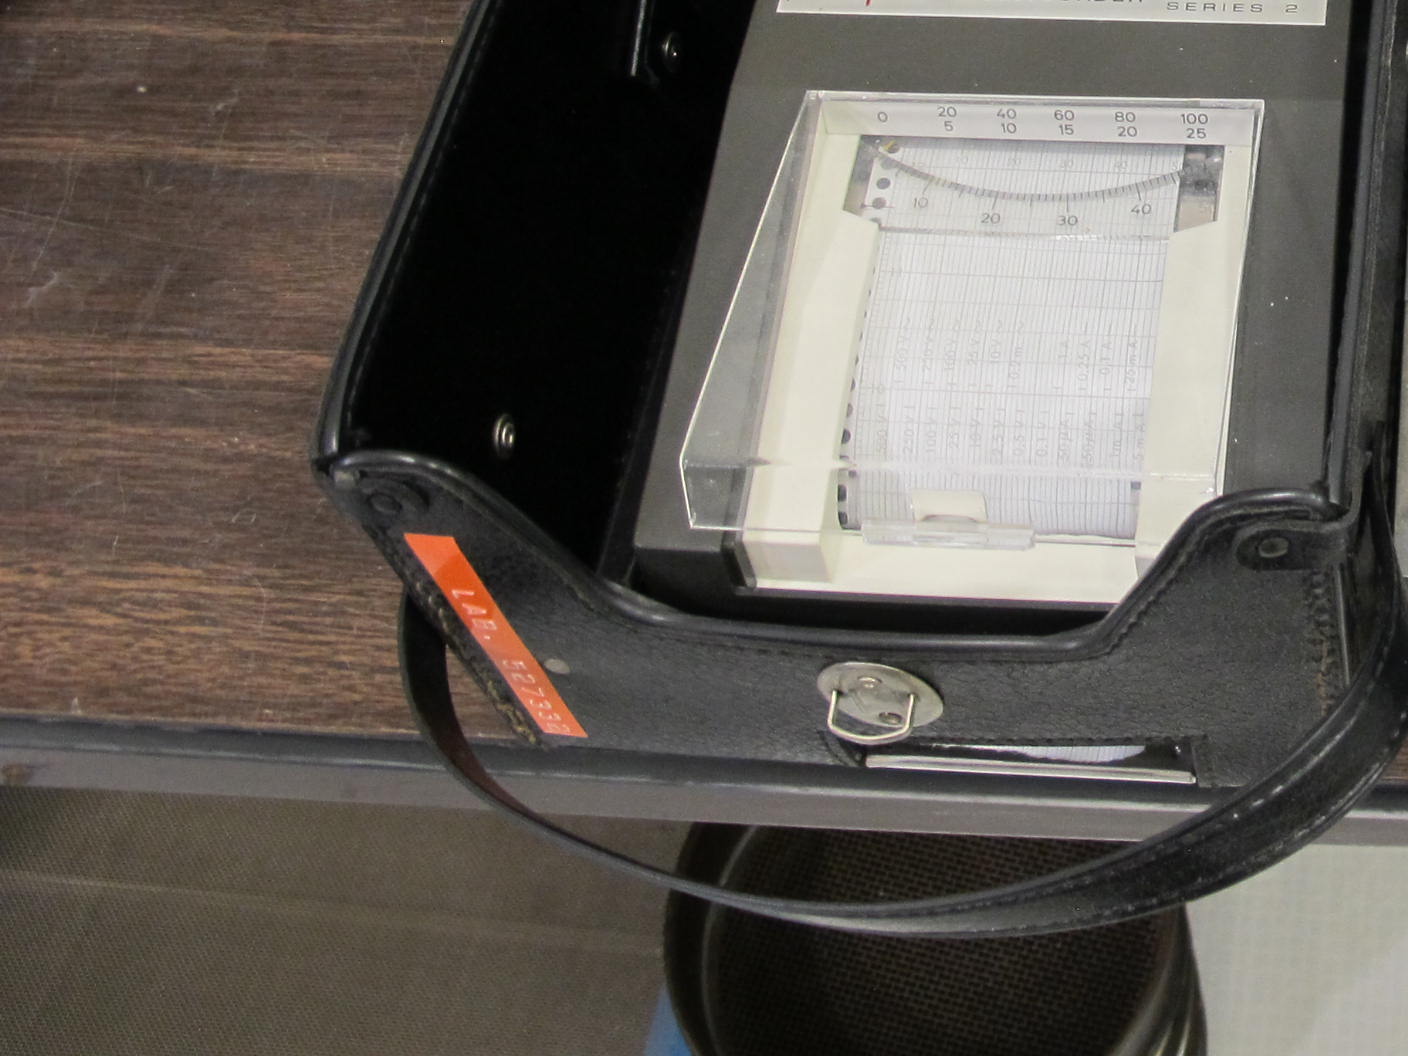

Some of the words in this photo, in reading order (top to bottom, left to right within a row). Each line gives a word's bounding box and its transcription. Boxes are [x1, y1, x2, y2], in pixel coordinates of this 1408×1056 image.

[1166, 1, 1264, 13] SERIES
[1285, 3, 1299, 14] 2
[876, 111, 888, 123] 0
[937, 106, 957, 118] 20
[996, 107, 1017, 120] 40
[1054, 109, 1075, 122] 60
[1114, 111, 1136, 124] 80
[1181, 112, 1209, 125] 100
[944, 120, 954, 132] 5
[1001, 122, 1017, 134] 10
[1058, 123, 1075, 136] 15
[1118, 125, 1138, 138] 20
[1186, 127, 1207, 139] 25
[913, 196, 929, 209] 10
[980, 212, 1001, 225] 20
[1058, 215, 1078, 227] 30
[1130, 202, 1153, 216] 40
[451, 588, 498, 640] LAB.
